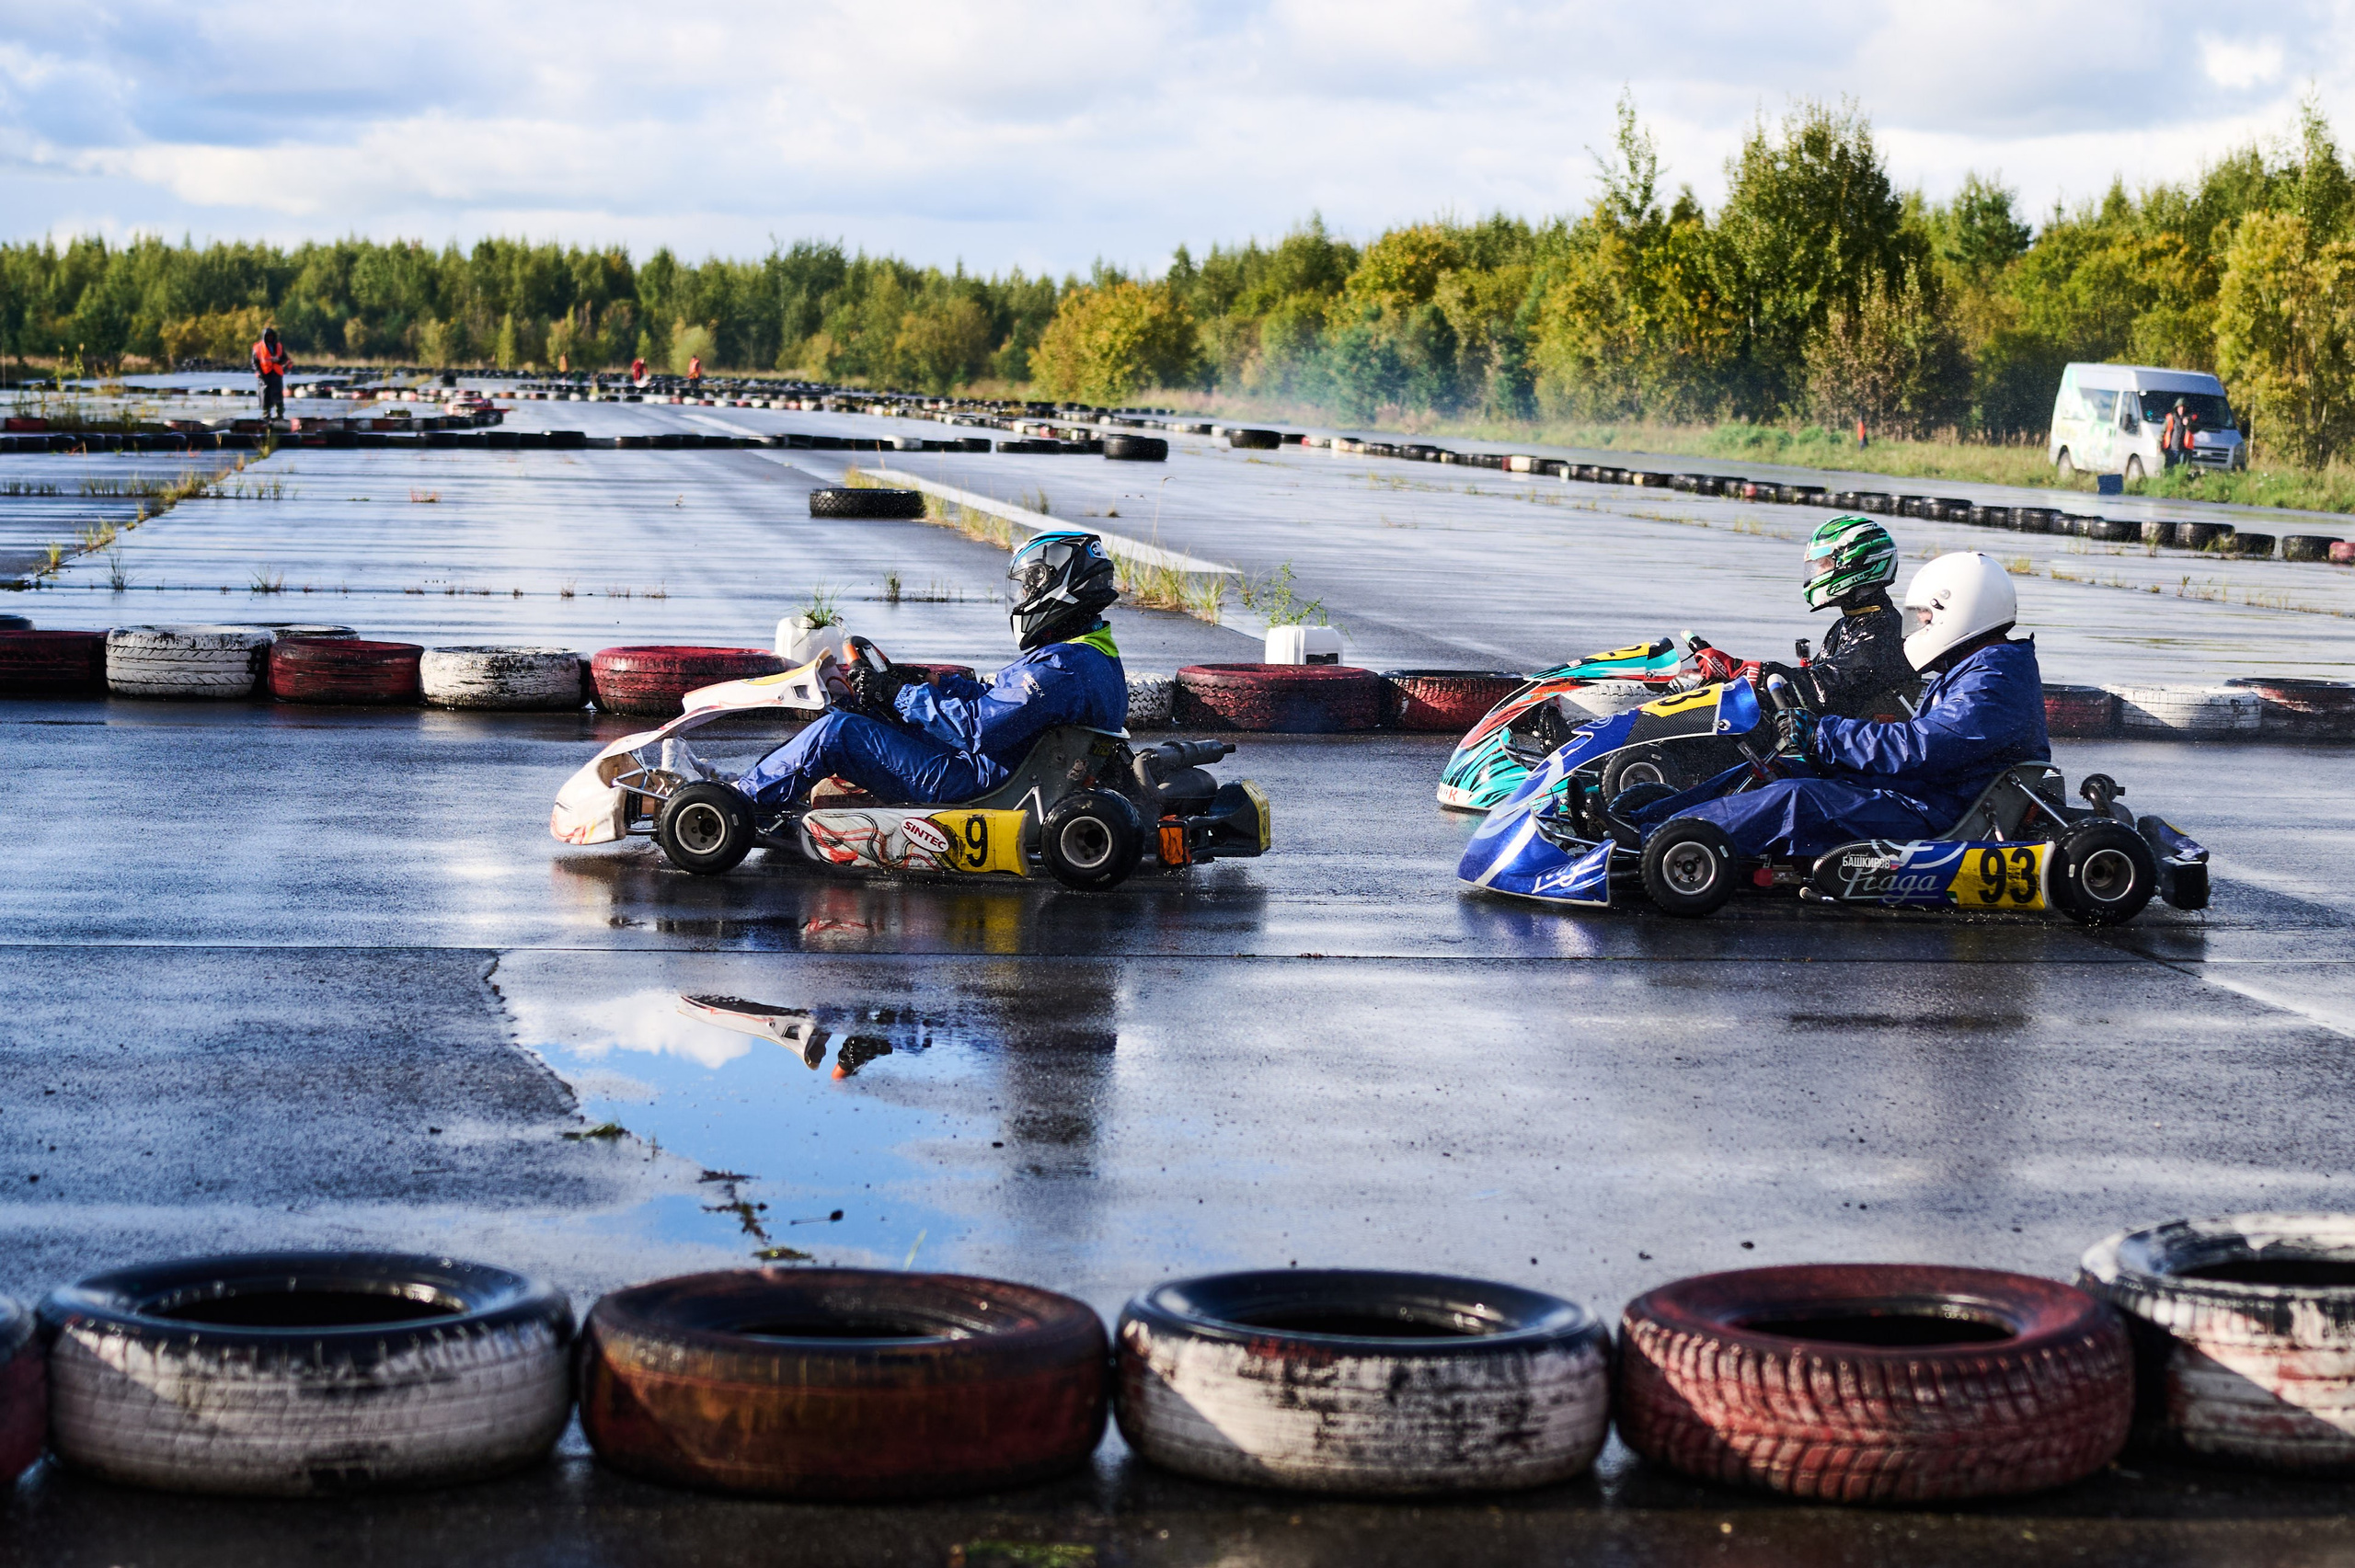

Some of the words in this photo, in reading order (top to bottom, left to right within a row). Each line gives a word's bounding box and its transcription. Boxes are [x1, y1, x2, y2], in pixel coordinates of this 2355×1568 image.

[903, 820, 947, 851] SINTEC
[965, 814, 989, 867] 9
[1842, 856, 1890, 869] БАШКИРОВ
[1979, 848, 2038, 904] 93
[1838, 865, 1940, 904] Praga
